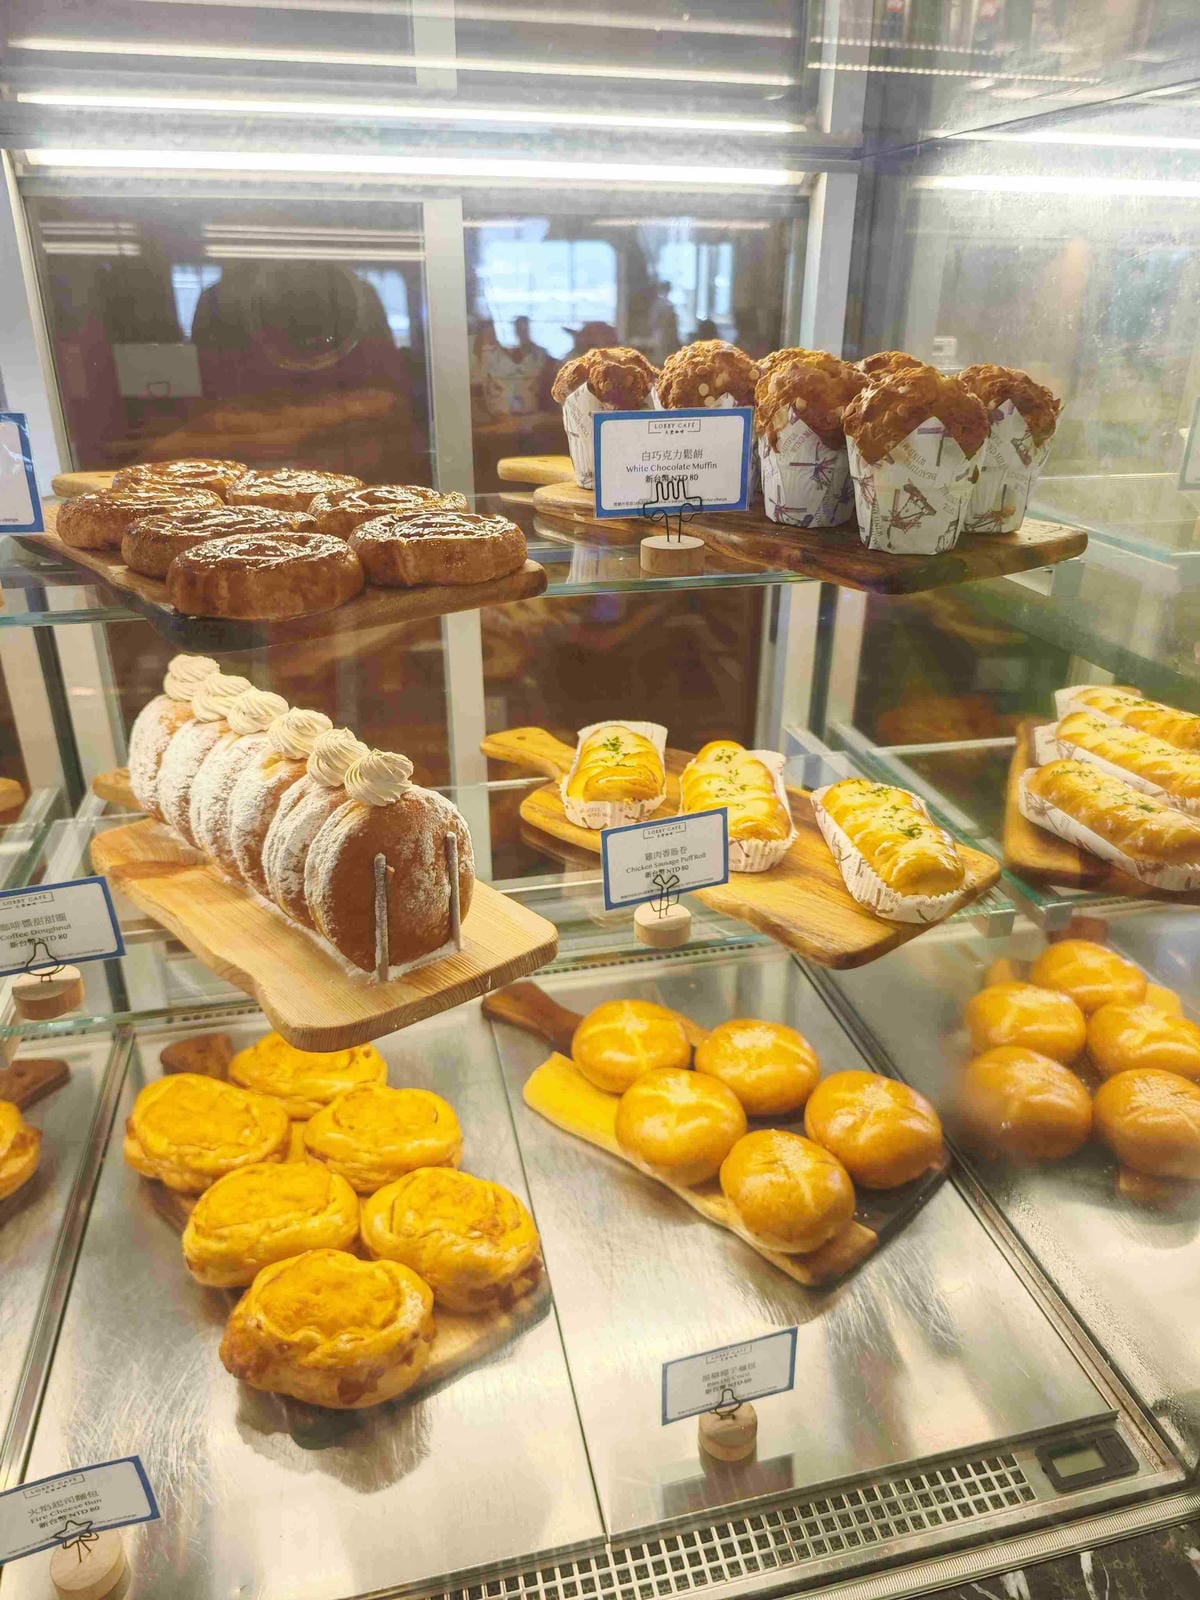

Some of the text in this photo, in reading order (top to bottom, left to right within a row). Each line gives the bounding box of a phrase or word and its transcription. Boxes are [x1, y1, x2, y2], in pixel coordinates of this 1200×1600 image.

[642, 448, 704, 461] 白巧克力鬆餅
[626, 461, 718, 473] White Chocolate Muffin
[690, 473, 699, 481] 80
[626, 863, 653, 874] Chicken
[654, 859, 679, 869] Sausage
